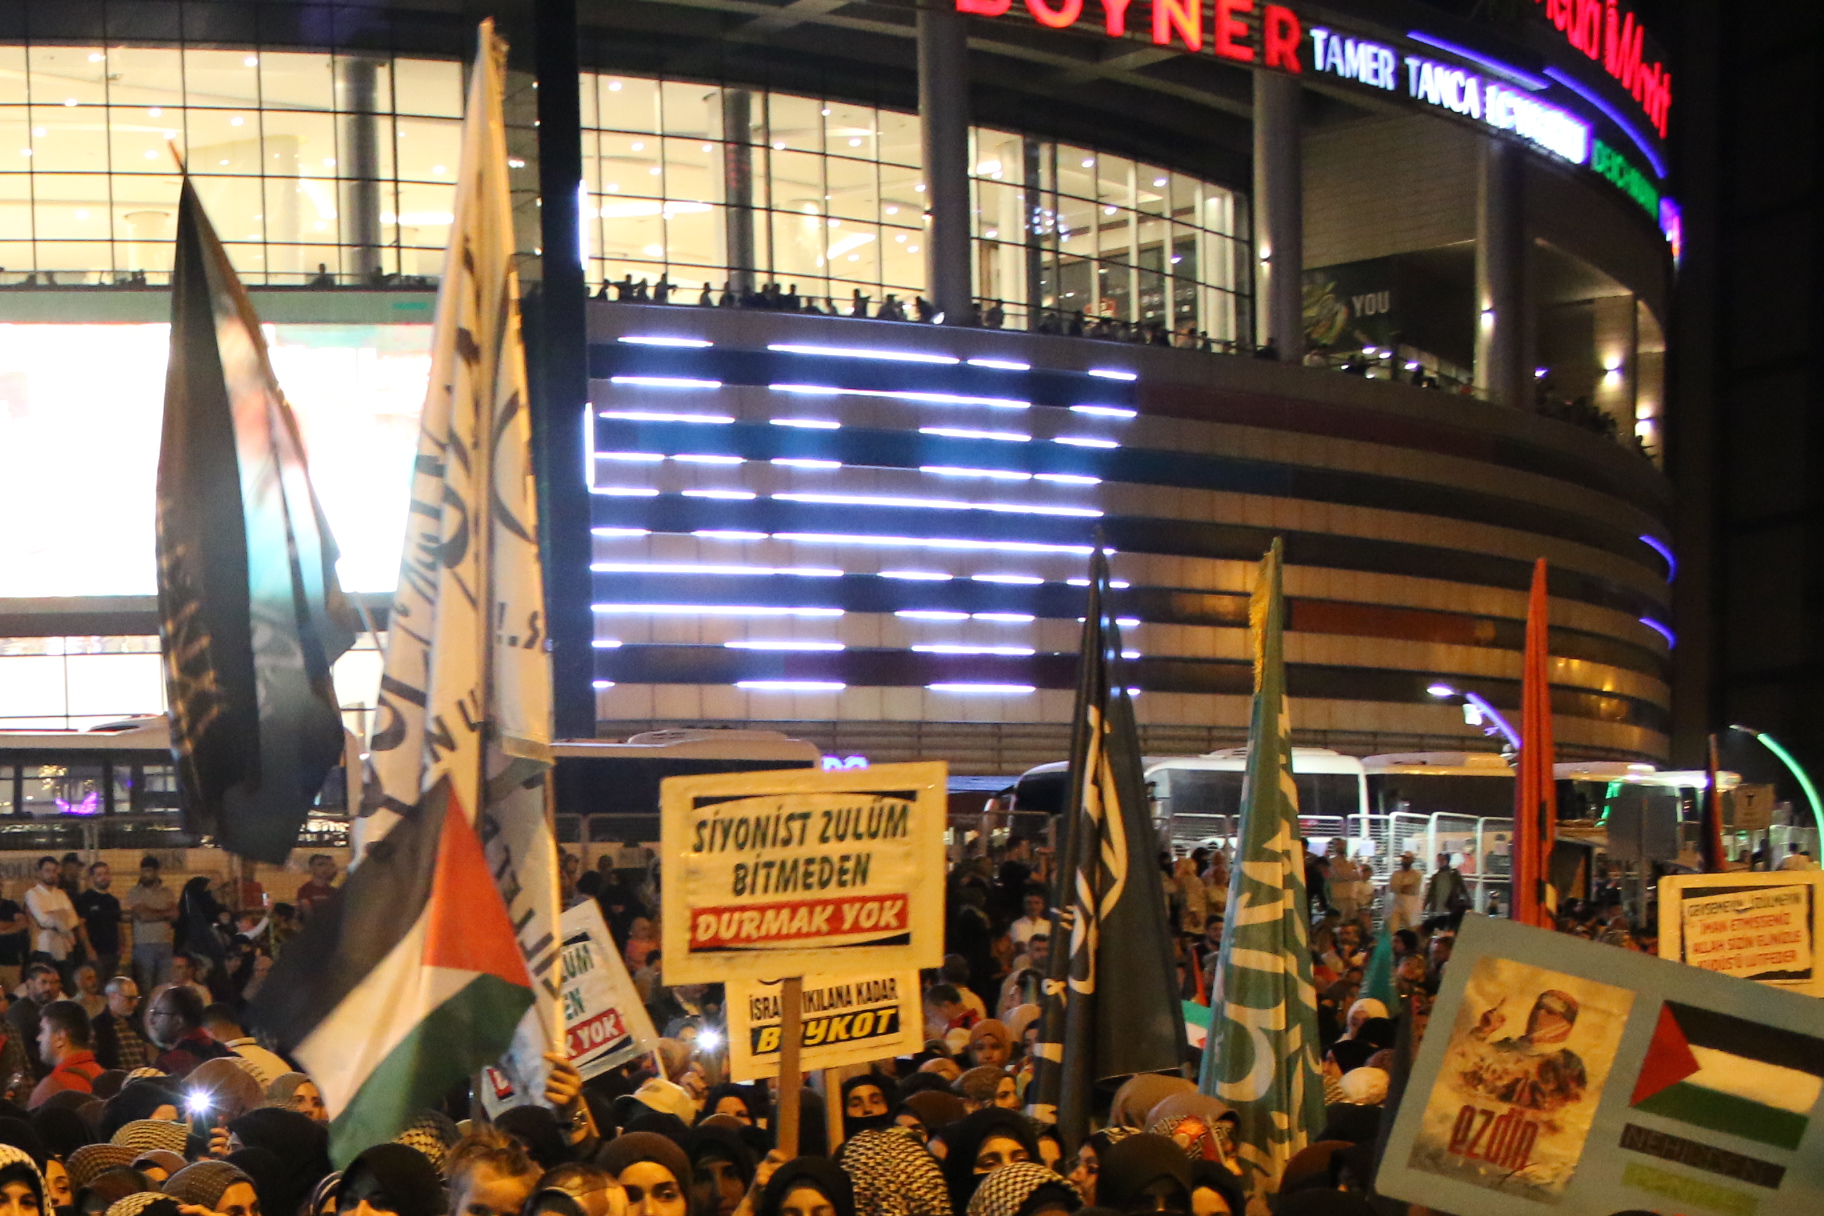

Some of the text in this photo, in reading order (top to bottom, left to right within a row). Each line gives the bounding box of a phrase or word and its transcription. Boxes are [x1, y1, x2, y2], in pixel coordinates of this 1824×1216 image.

[1310, 28, 1481, 119] TAMER TANCA
[1353, 291, 1390, 317] YOU
[692, 795, 910, 854] SİYONİST ZULÜM
[732, 853, 871, 897] BİTMEDEN
[694, 899, 904, 943] DURMAK YOK
[749, 977, 898, 1021] İSRA IKILANA KADAR
[577, 1010, 619, 1050] YOK
[755, 1007, 896, 1053] BYKOT
